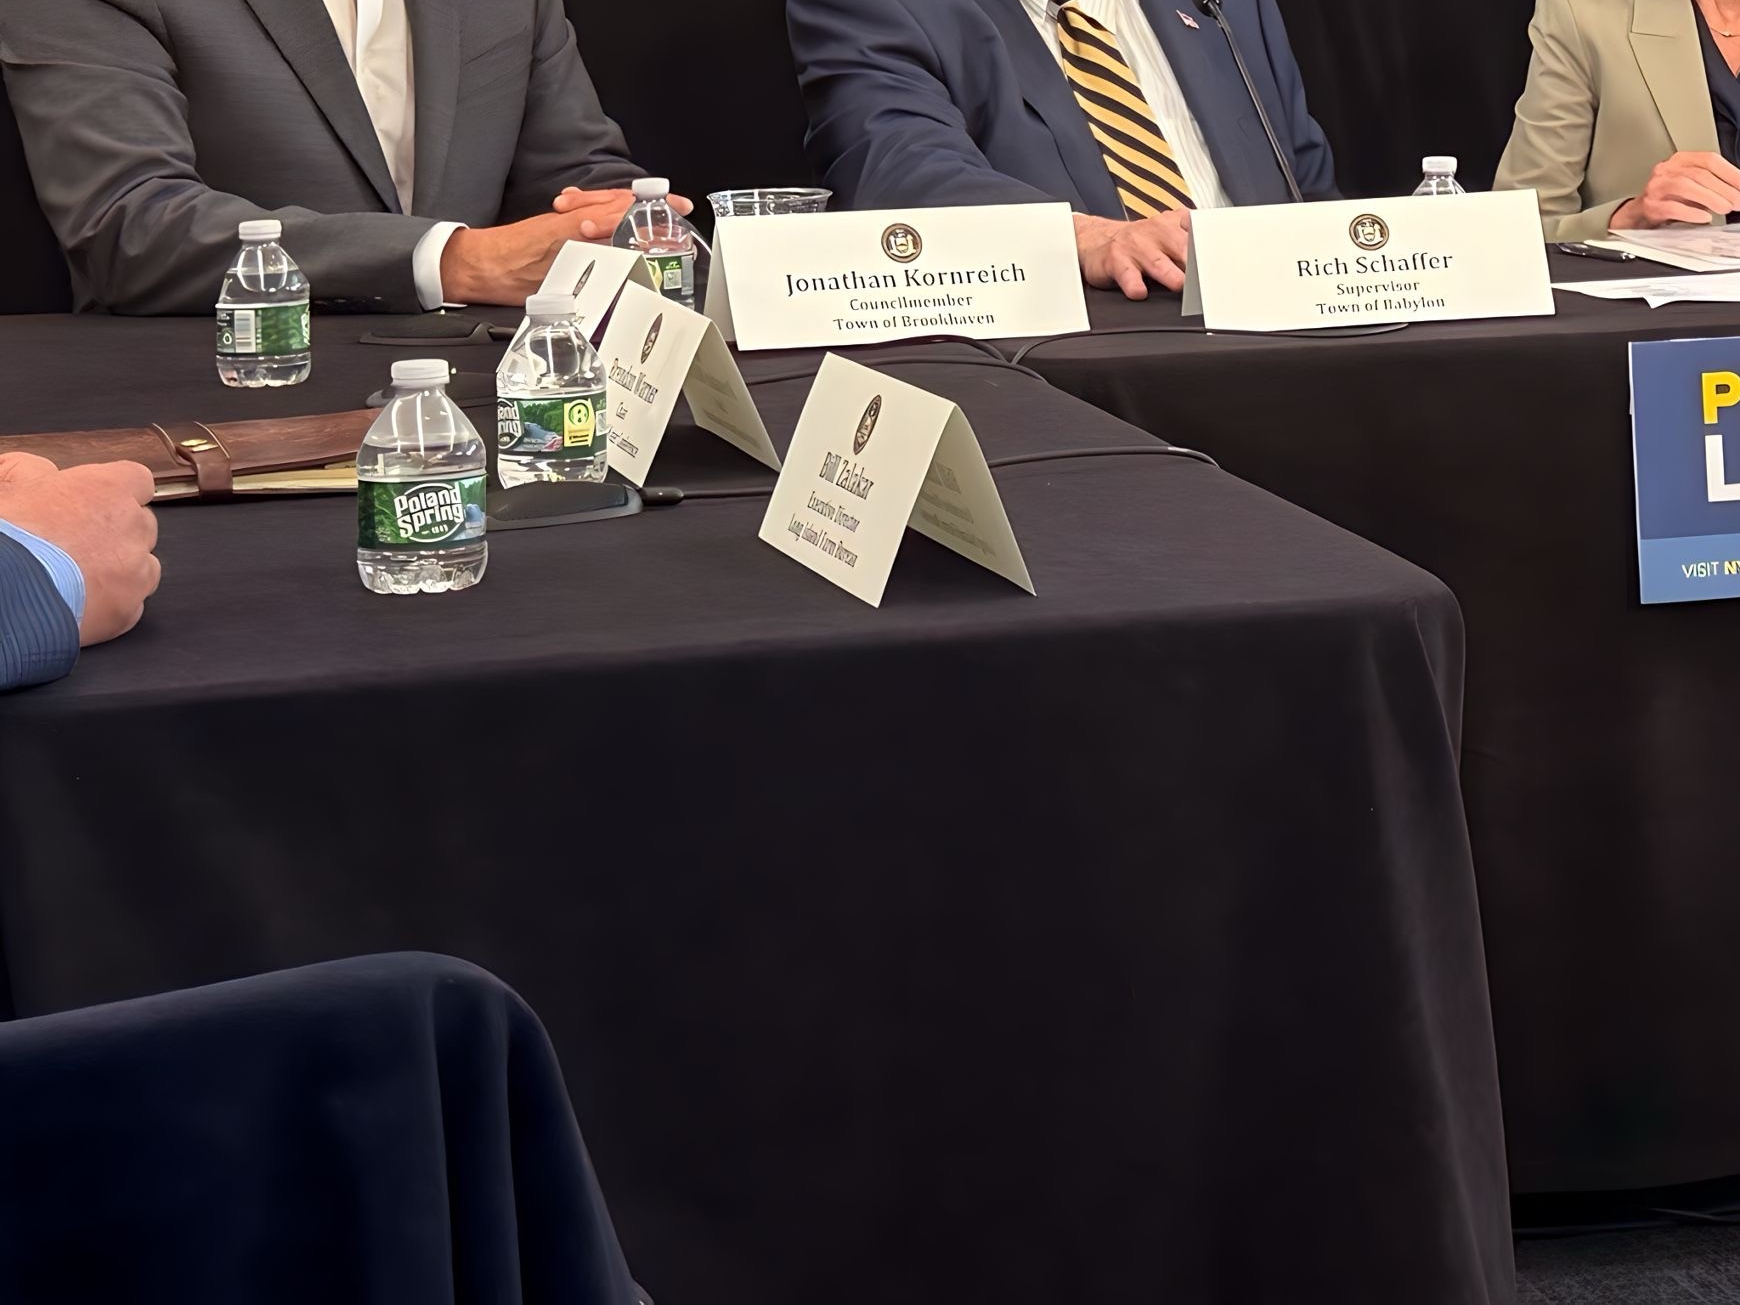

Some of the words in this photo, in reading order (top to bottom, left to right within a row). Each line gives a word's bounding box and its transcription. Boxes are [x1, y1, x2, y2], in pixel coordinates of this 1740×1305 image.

[1297, 257, 1349, 277] Rich
[1355, 251, 1453, 275] Schaffer
[785, 270, 897, 297] Jonathan
[903, 263, 1027, 287] Kornreich
[1336, 281, 1421, 297] Supervisor
[850, 294, 973, 311] Councilmember
[1315, 301, 1361, 315] Town
[1364, 299, 1379, 312] of
[832, 317, 879, 331] Town
[882, 316, 898, 329] of
[901, 312, 996, 328] Brookhaven
[393, 480, 462, 519] Poland
[397, 503, 465, 538] Spring
[1681, 561, 1720, 579] VISIT
